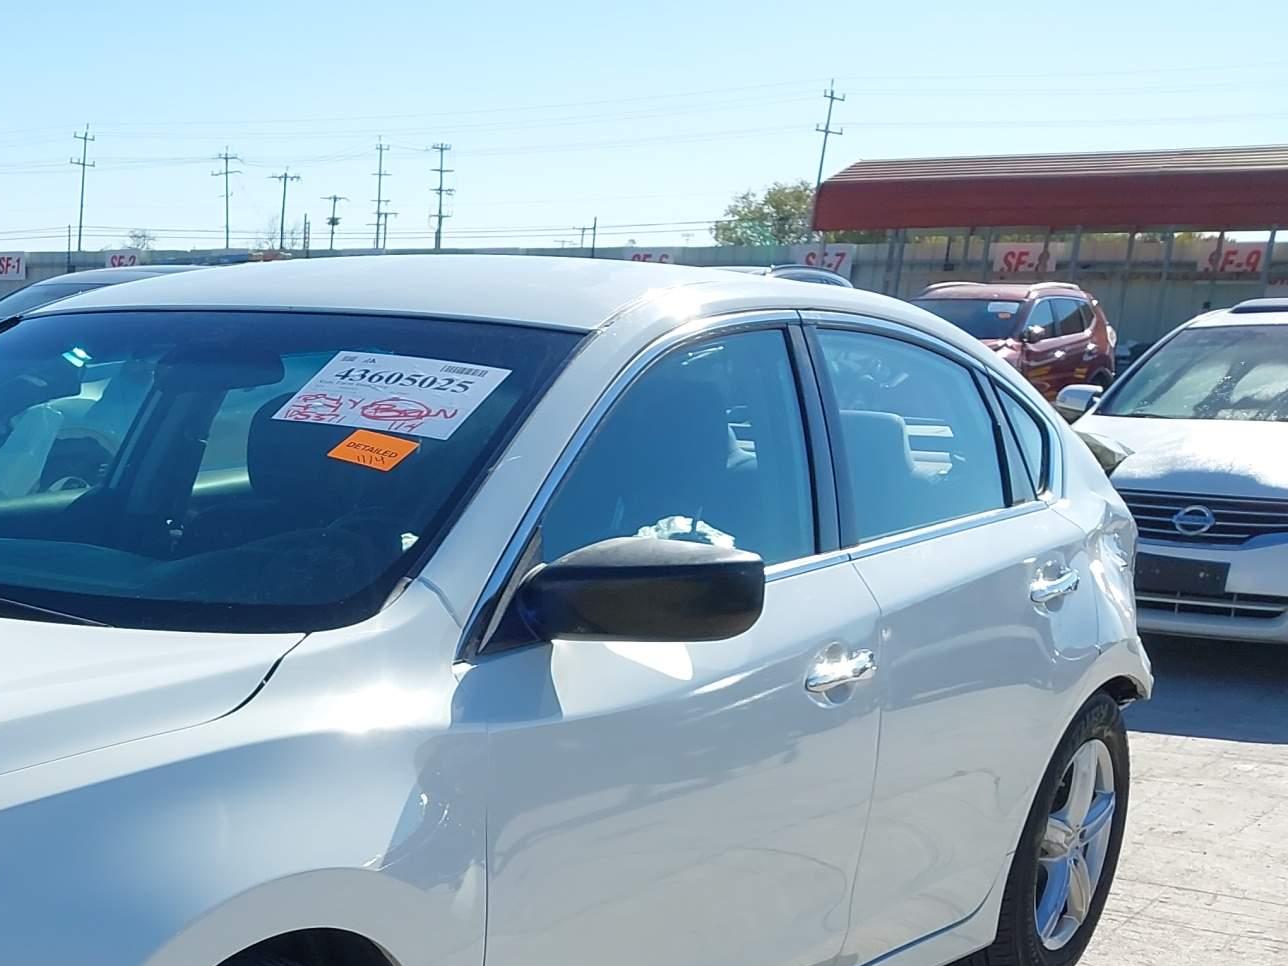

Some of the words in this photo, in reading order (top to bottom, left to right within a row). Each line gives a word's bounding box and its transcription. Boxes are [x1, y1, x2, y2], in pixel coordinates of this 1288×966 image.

[1000, 250, 1047, 272] SF-
[333, 367, 475, 394] 43605025
[346, 441, 399, 459] DETAILED
